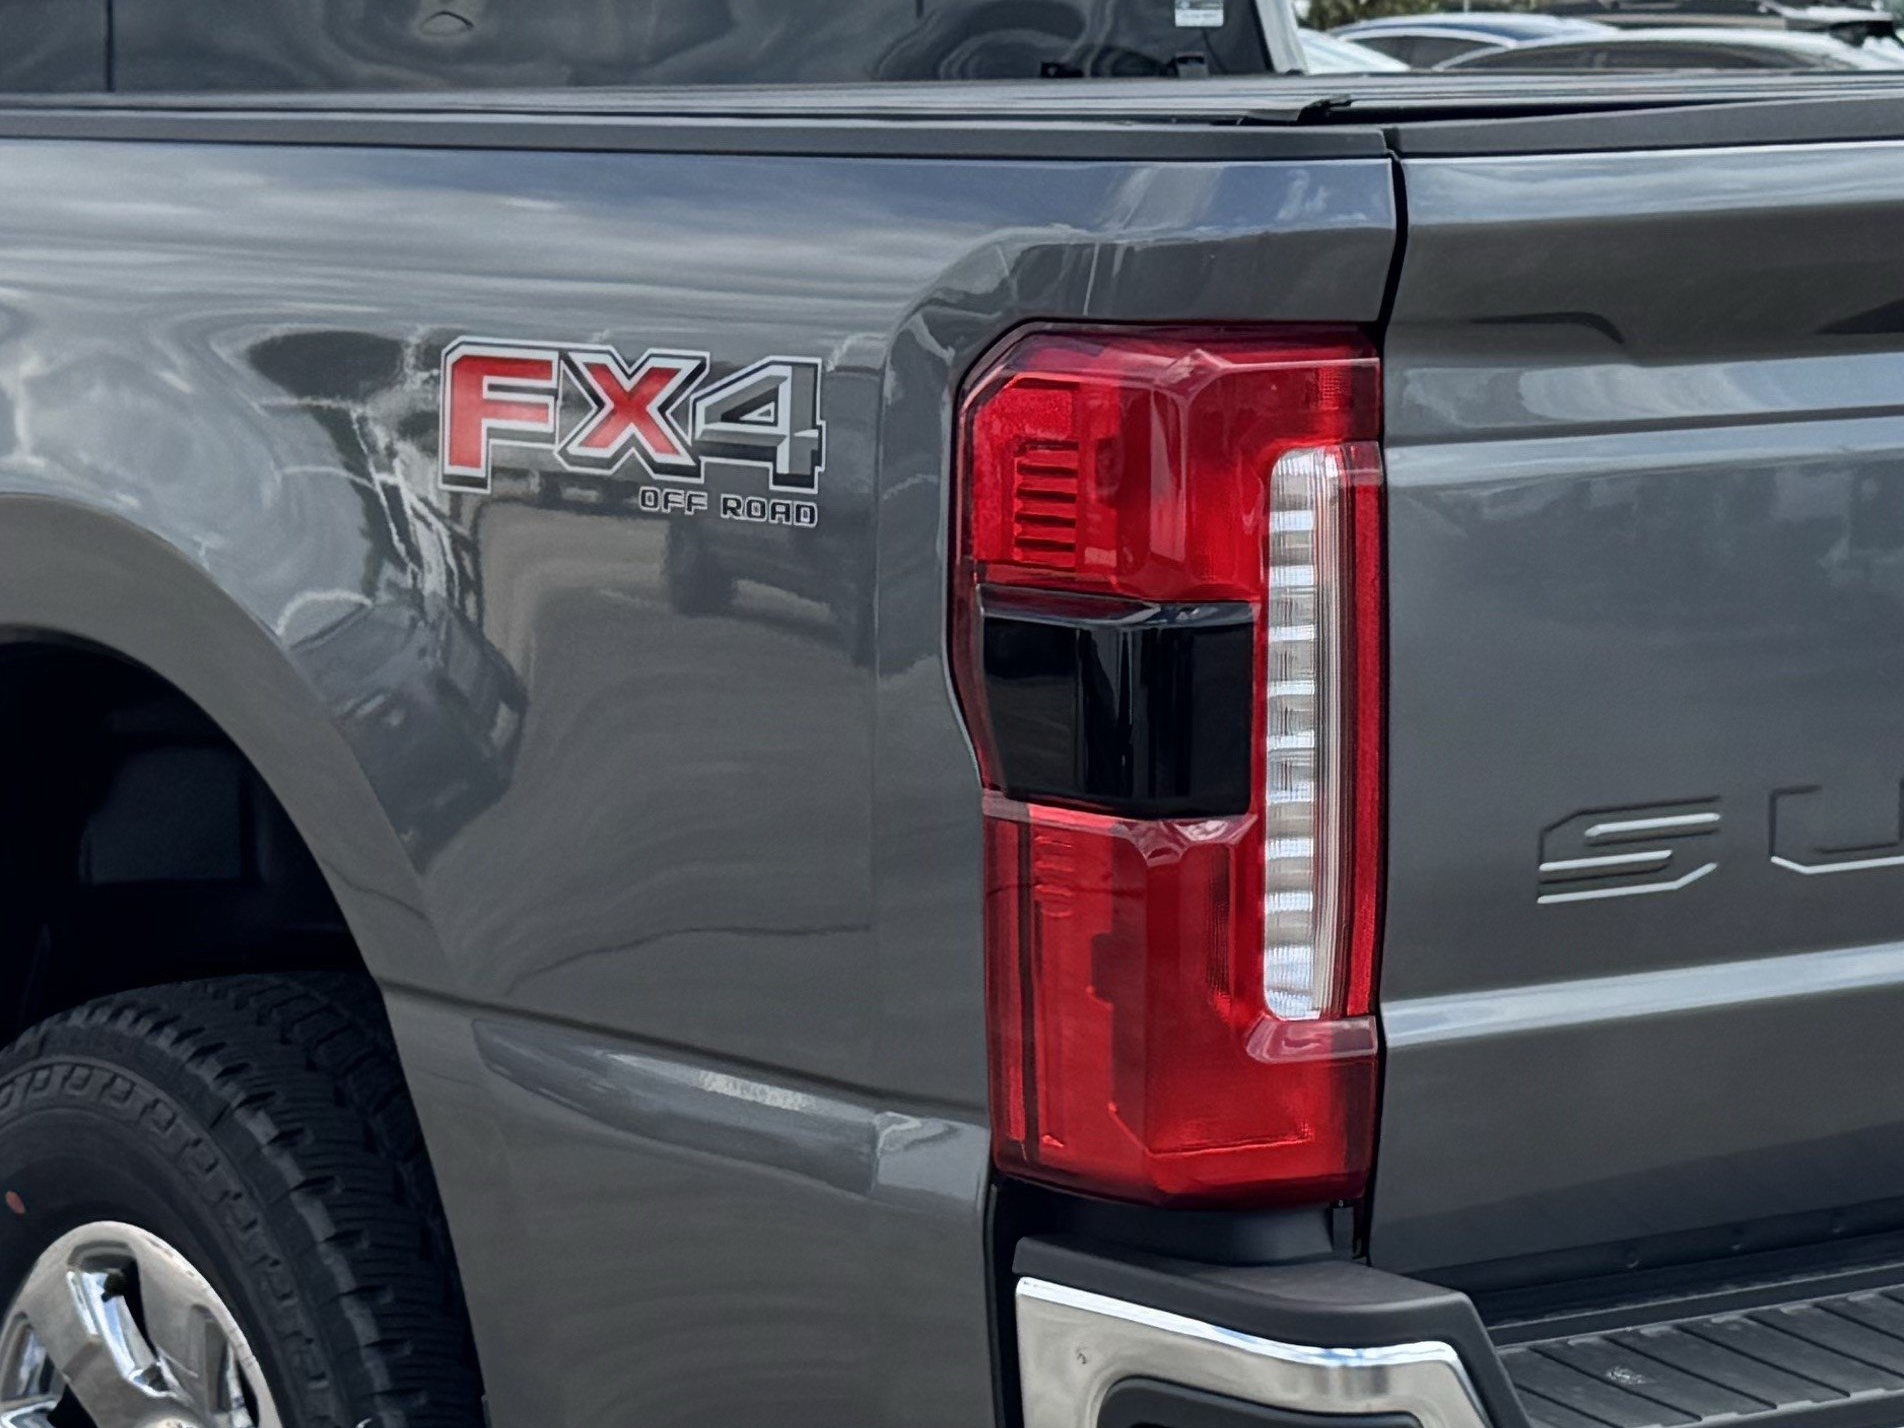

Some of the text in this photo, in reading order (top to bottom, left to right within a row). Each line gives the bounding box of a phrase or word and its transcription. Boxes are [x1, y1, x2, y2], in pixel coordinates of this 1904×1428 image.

[438, 335, 826, 494] FX4
[639, 486, 819, 528] OFF ROAD
